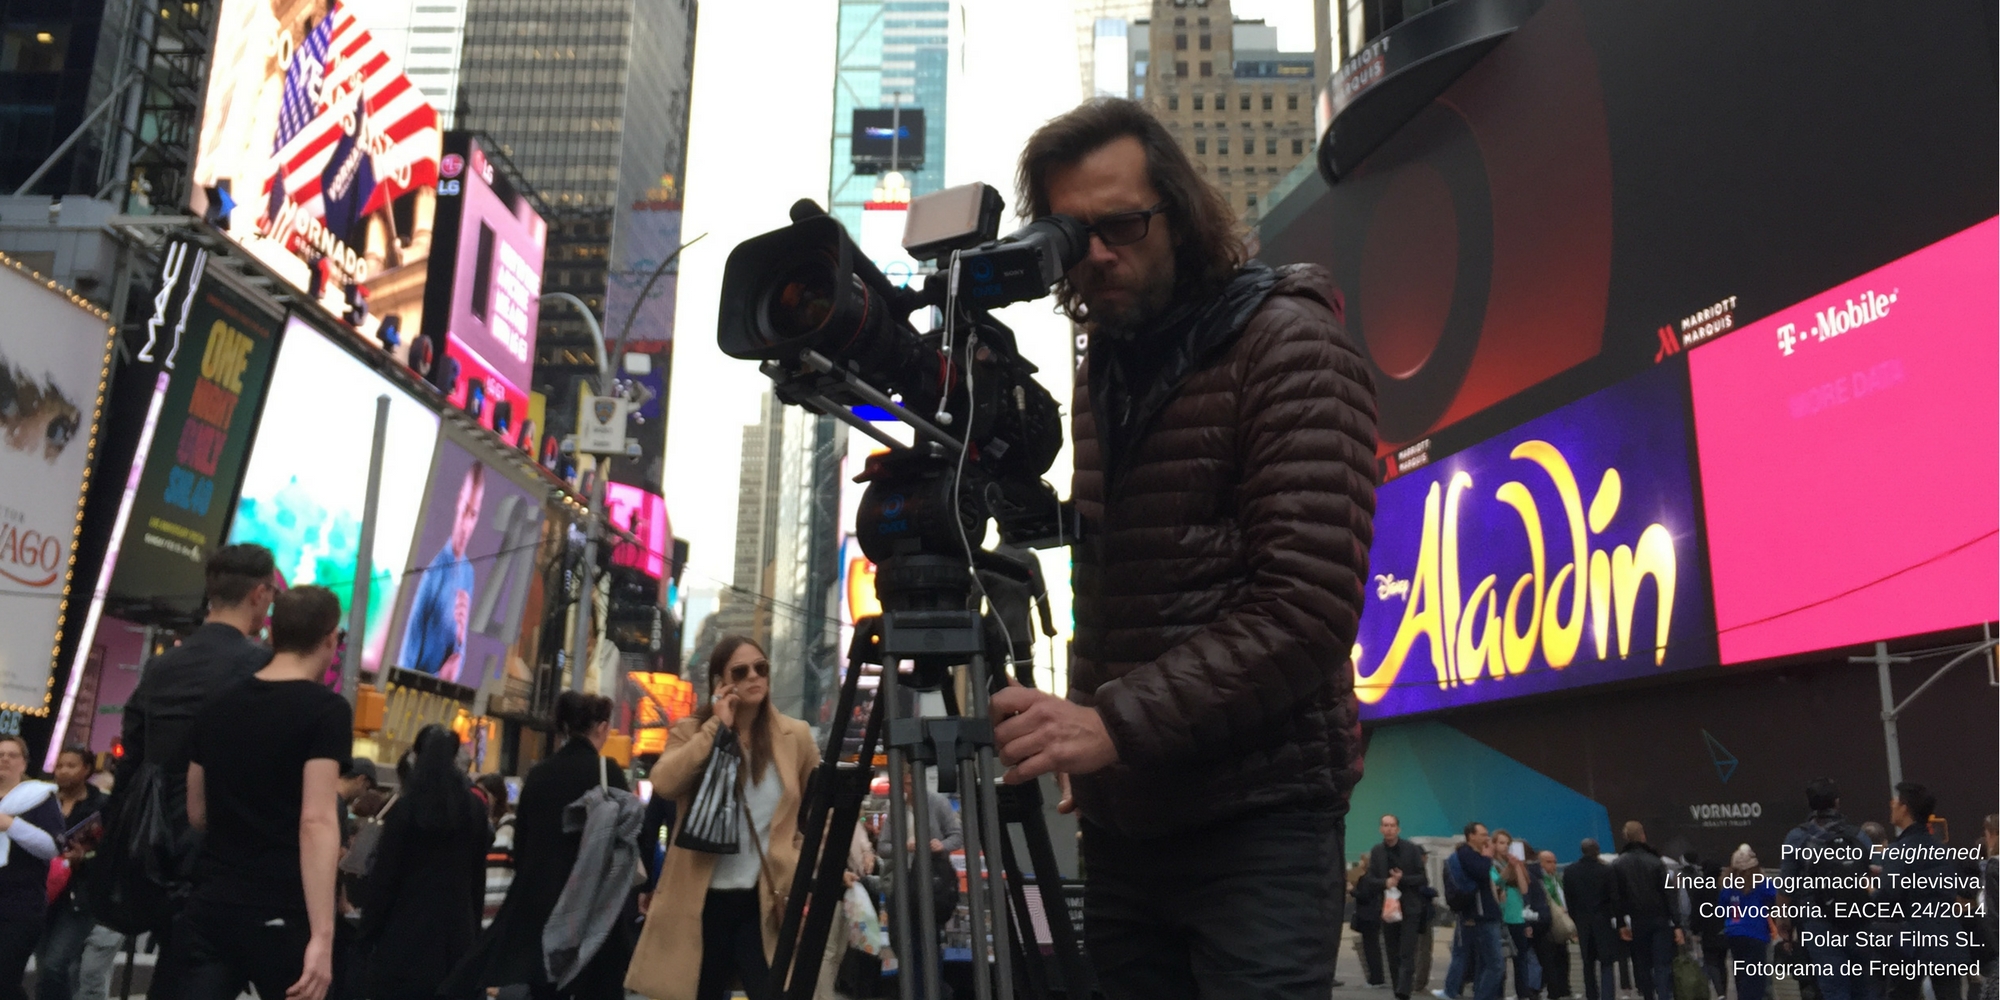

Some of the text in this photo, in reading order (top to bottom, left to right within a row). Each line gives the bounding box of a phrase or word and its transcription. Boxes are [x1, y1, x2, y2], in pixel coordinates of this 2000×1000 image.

[438, 180, 460, 195] LG
[1003, 269, 1024, 277] SONY
[1681, 295, 1737, 332] MARRIOTT
[1682, 314, 1732, 347] MARQUIS
[202, 320, 254, 395] ONE
[1350, 440, 1676, 704] Aladdin
[1689, 802, 1762, 820] VORNADO
